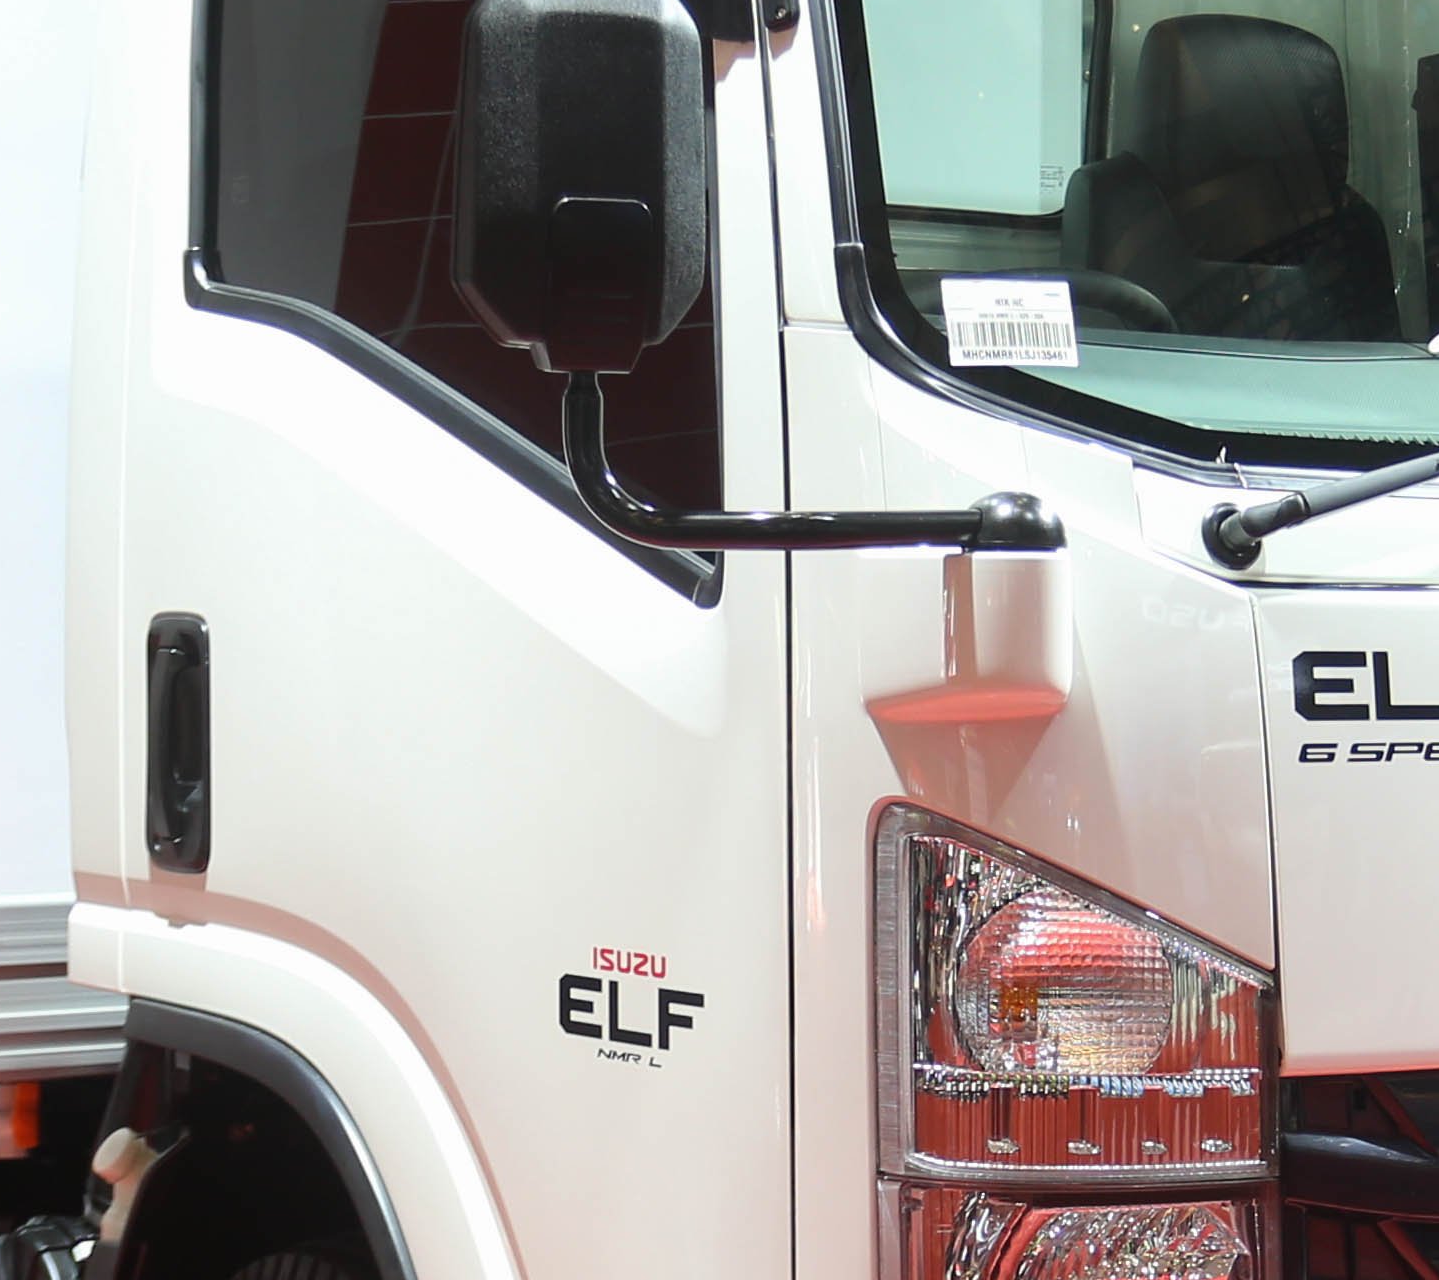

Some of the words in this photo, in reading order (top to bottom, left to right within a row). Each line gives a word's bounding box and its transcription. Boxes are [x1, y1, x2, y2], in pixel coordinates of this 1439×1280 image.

[1299, 743, 1338, 763] 6
[592, 946, 667, 979] ISUZU
[559, 973, 705, 1050] ELF
[597, 1047, 642, 1064] NMR
[649, 1056, 662, 1068] L
